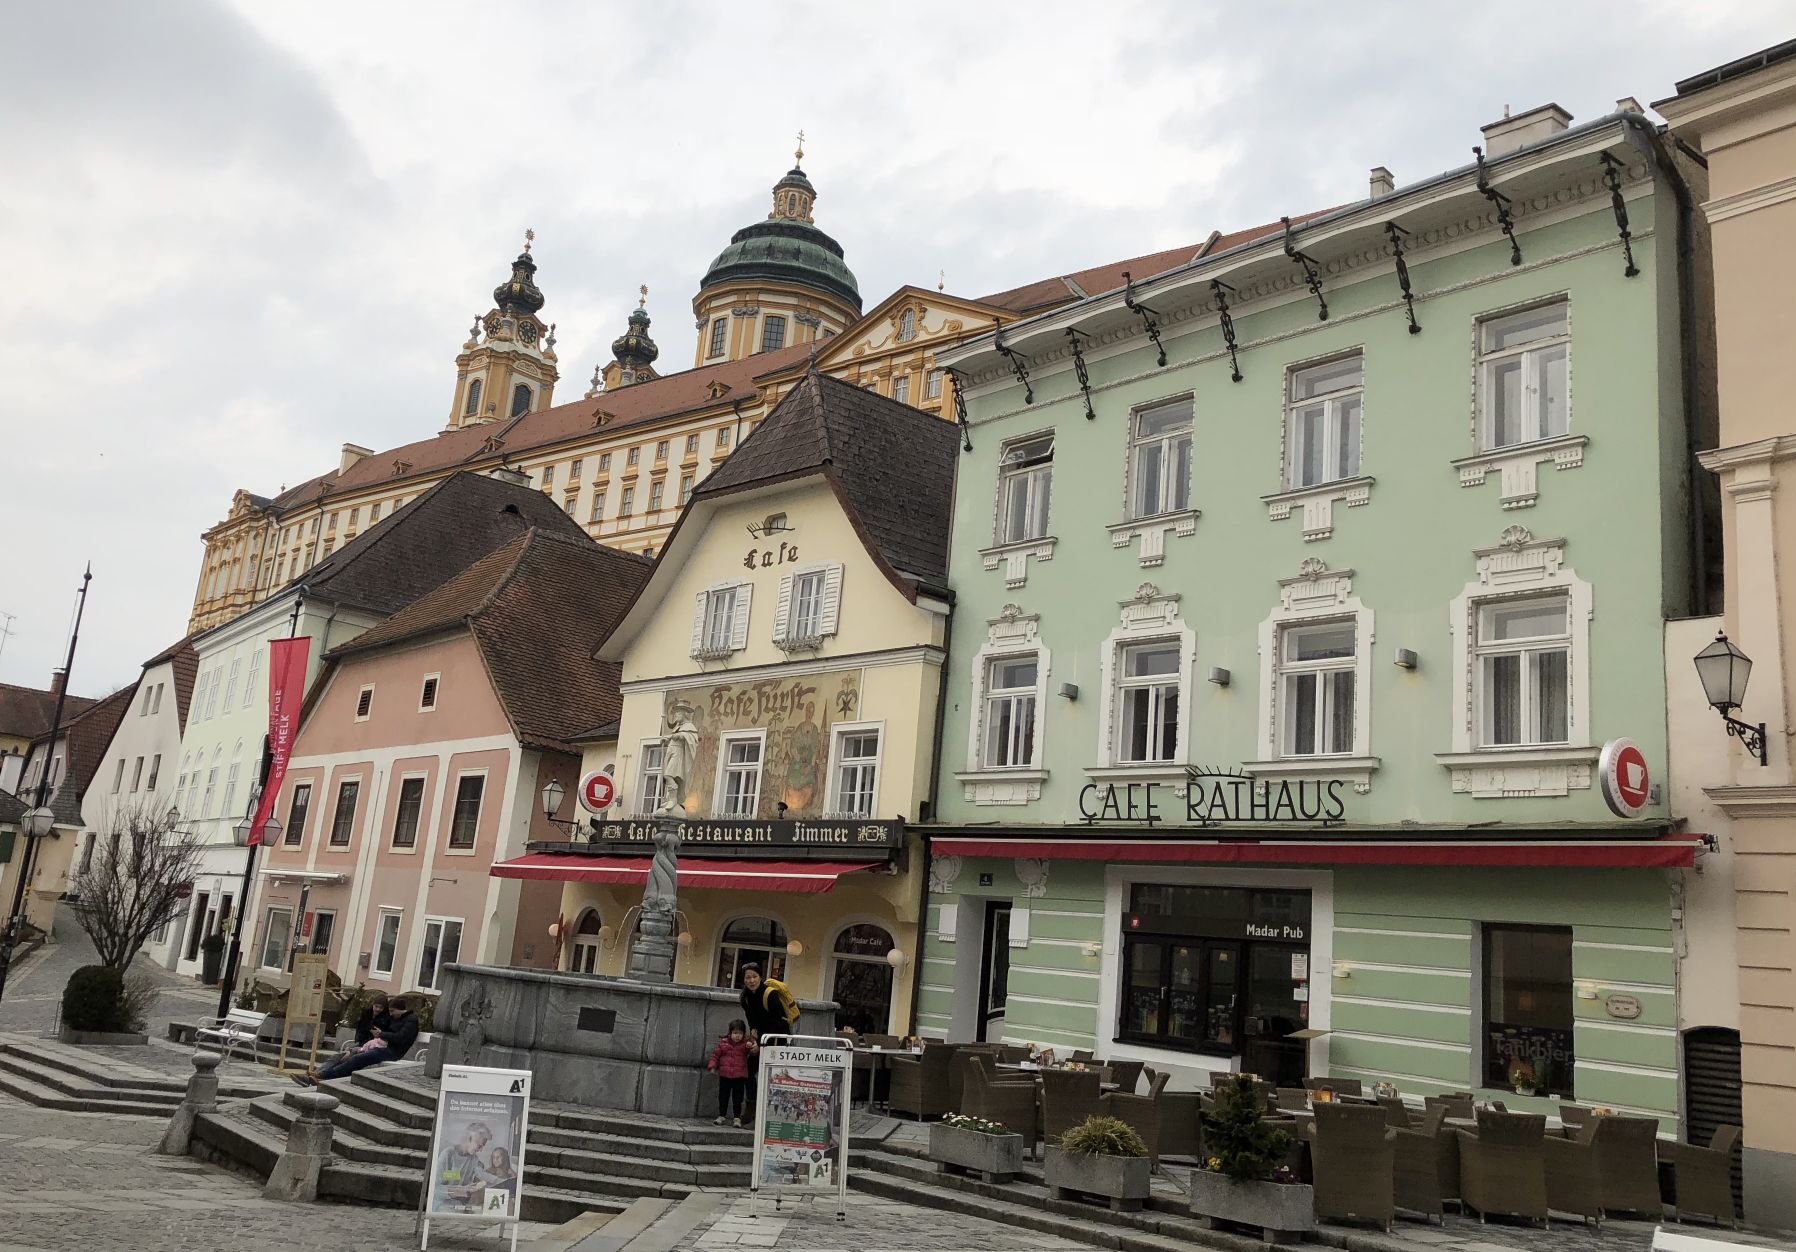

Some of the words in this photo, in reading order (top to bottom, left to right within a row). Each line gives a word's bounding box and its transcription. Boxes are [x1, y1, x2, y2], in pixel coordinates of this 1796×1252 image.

[751, 678, 817, 726] Fürst
[278, 714, 290, 745] MELK
[275, 744, 286, 779] STIFT
[1079, 783, 1161, 821] CAFE
[1186, 780, 1345, 821] RATHAUS
[627, 822, 657, 842] Cafe
[677, 824, 772, 842] Restaurant
[792, 822, 849, 843] Zimmer
[1246, 923, 1280, 937] Madar
[1283, 925, 1304, 939] Pub
[780, 1051, 812, 1061] STADT
[814, 1053, 842, 1063] MELK
[509, 1078, 525, 1093] A1
[813, 1162, 829, 1178] A1
[488, 1193, 505, 1210] A1
